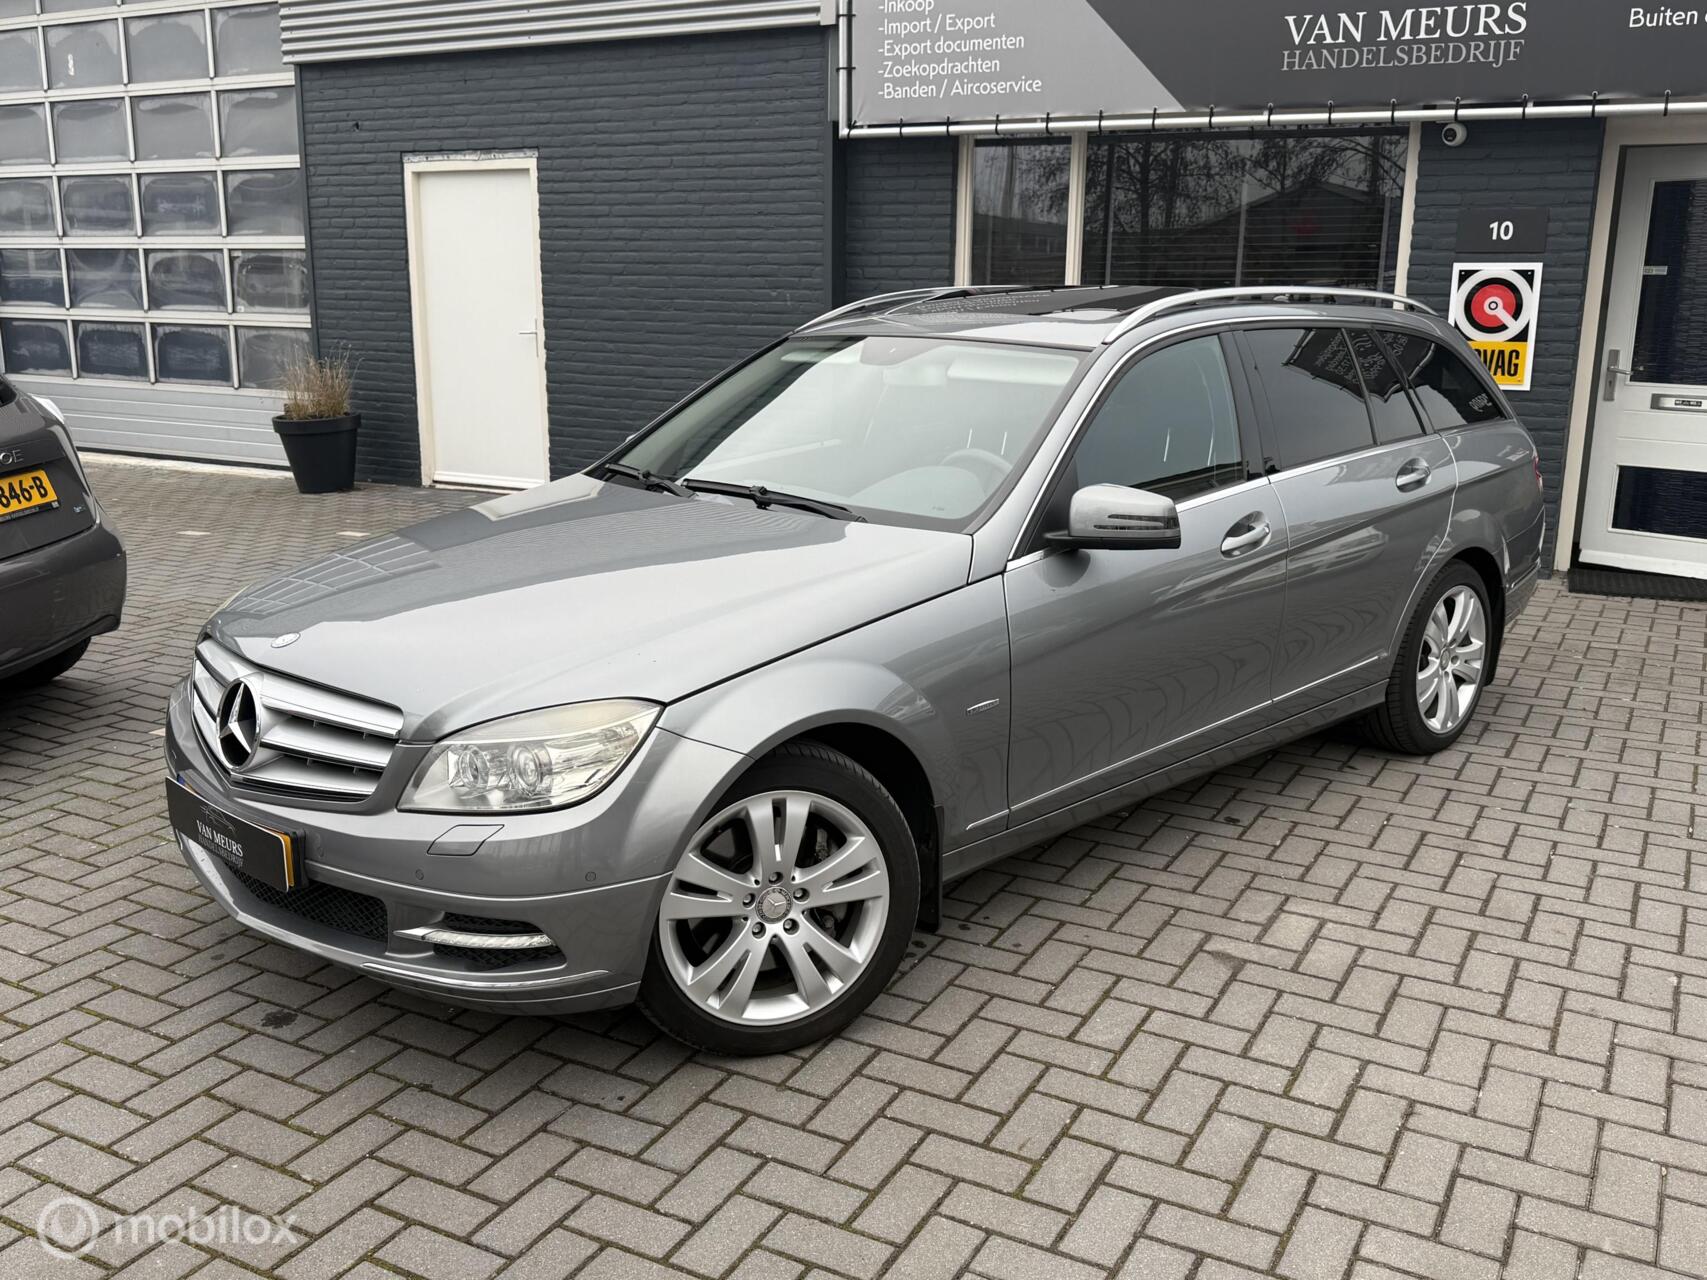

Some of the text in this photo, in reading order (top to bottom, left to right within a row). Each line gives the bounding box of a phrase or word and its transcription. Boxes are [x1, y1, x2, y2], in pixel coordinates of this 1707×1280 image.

[878, 13, 995, 38] -Import / Export
[1284, 1, 1528, 46] VAN MEURS
[1629, 6, 1698, 28] Buiten
[878, 36, 1025, 60] -Export documenten
[1281, 39, 1525, 71] HANDELSBEDRIJF
[877, 57, 1000, 80] -Zoekopdrachten
[877, 76, 1042, 99] -Banden / Aircoservice
[1489, 220, 1514, 241] 10
[196, 819, 244, 857] VAN MEURS
